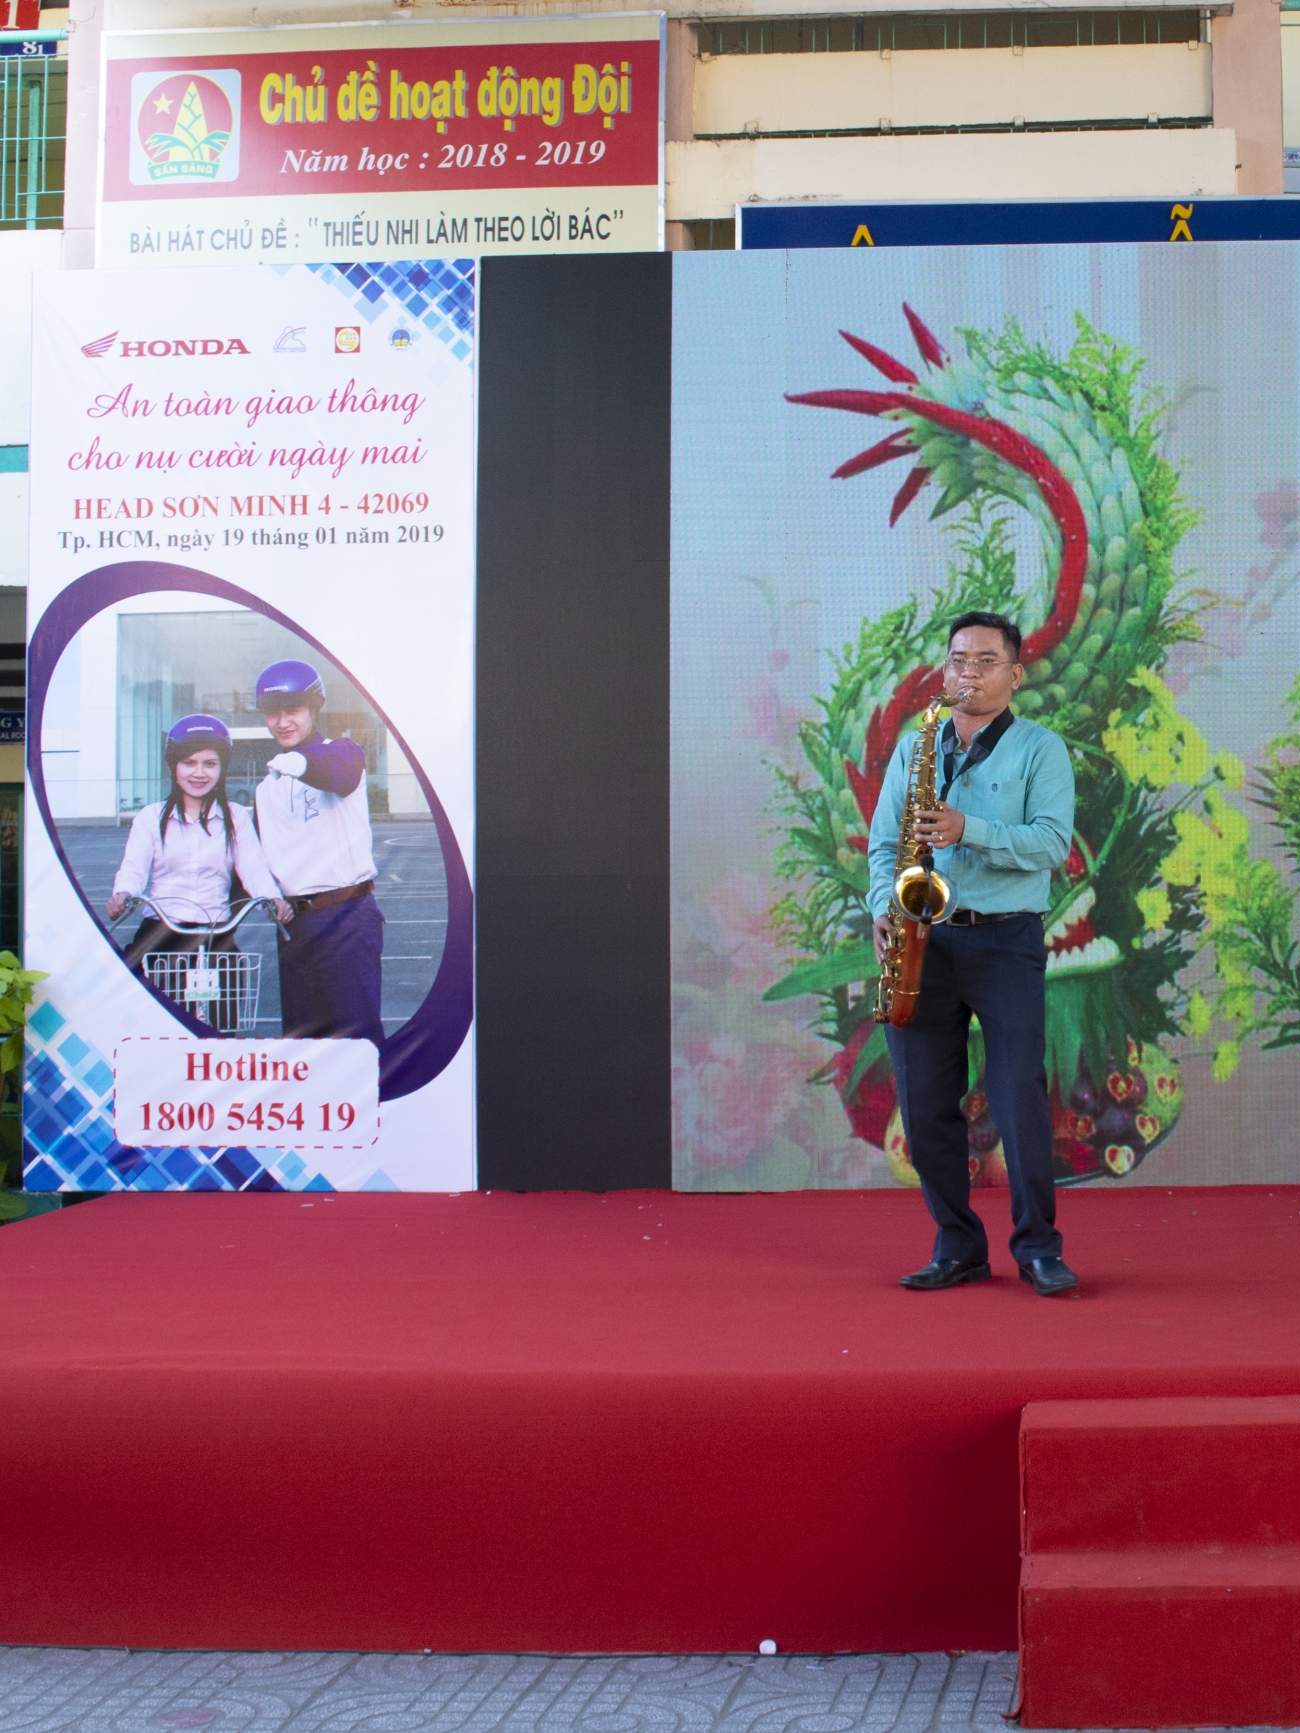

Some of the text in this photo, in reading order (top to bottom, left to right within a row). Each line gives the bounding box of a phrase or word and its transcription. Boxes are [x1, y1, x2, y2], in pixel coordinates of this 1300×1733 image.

[258, 61, 632, 134] Chủ đề hoạt động Đội
[279, 149, 348, 176] Năm
[358, 146, 410, 176] học
[438, 143, 507, 169] 2018
[535, 141, 605, 166] 2019
[130, 226, 161, 254] BÀI
[168, 224, 205, 252] HÁT
[210, 221, 253, 251] CHỦ
[261, 217, 287, 249] ĐỀ
[323, 210, 380, 246] THIẾU
[386, 219, 419, 244] NHI
[426, 211, 469, 244] LÀM
[474, 215, 524, 242] THEO
[531, 208, 562, 242] LỜI
[120, 338, 251, 357] HONDA
[86, 378, 426, 428] An toàn giao thông
[68, 436, 428, 479] cho nụ cười ngày mai
[73, 498, 153, 519] HEAD
[163, 494, 219, 518] SƠN
[230, 494, 309, 516] MINH
[318, 494, 331, 514] 4
[357, 492, 429, 514] 42069
[58, 524, 444, 553] Tp. HCM, ngày 19 tháng 01 năm 2019
[185, 1052, 309, 1082] Hotline
[141, 1102, 355, 1132] 1800 5454 19
